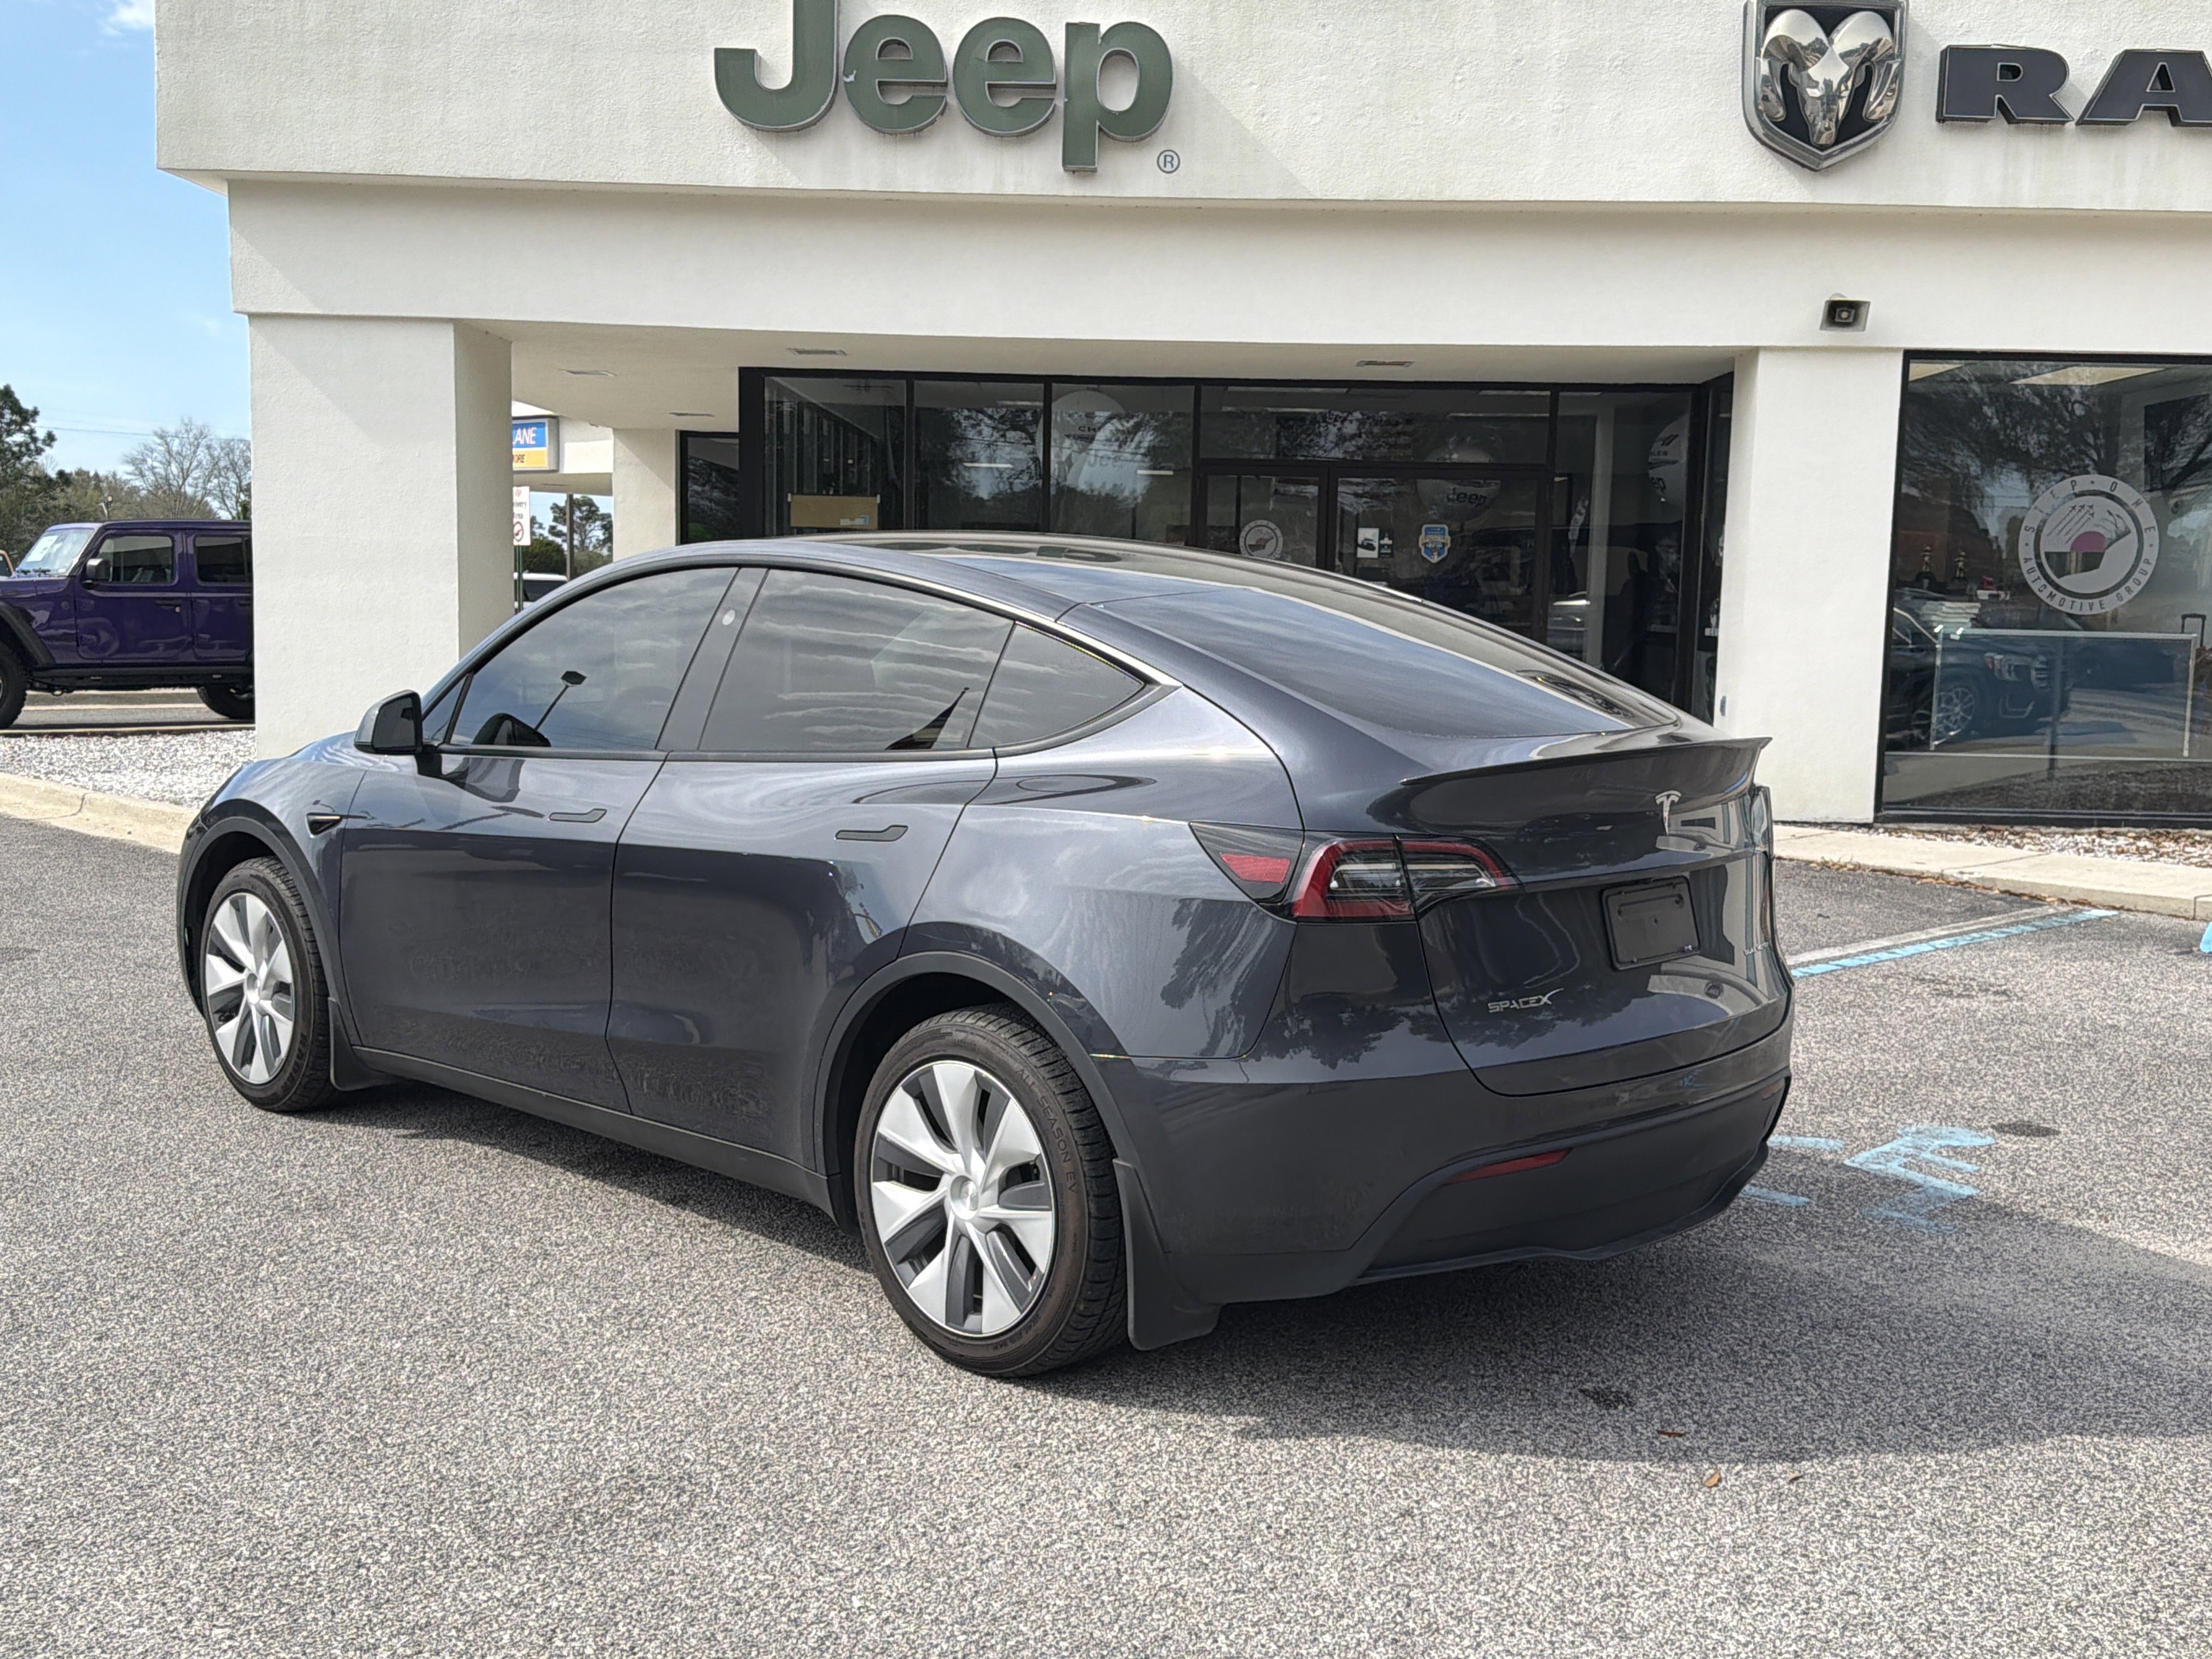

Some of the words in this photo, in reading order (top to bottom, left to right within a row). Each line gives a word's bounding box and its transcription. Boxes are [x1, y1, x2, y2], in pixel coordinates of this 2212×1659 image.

[714, 0, 1173, 172] Jeep
[512, 426, 537, 445] ANE
[2024, 479, 2078, 534] STEP
[2109, 481, 2156, 534] ONE
[2023, 557, 2106, 612] AUTOMOTIVE
[2115, 557, 2153, 602] GROUP
[1487, 988, 1565, 1013] SPACEX
[1015, 1068, 1036, 1092] ALL
[1036, 1094, 1071, 1164] SEASON
[1066, 1171, 1078, 1194] EV
